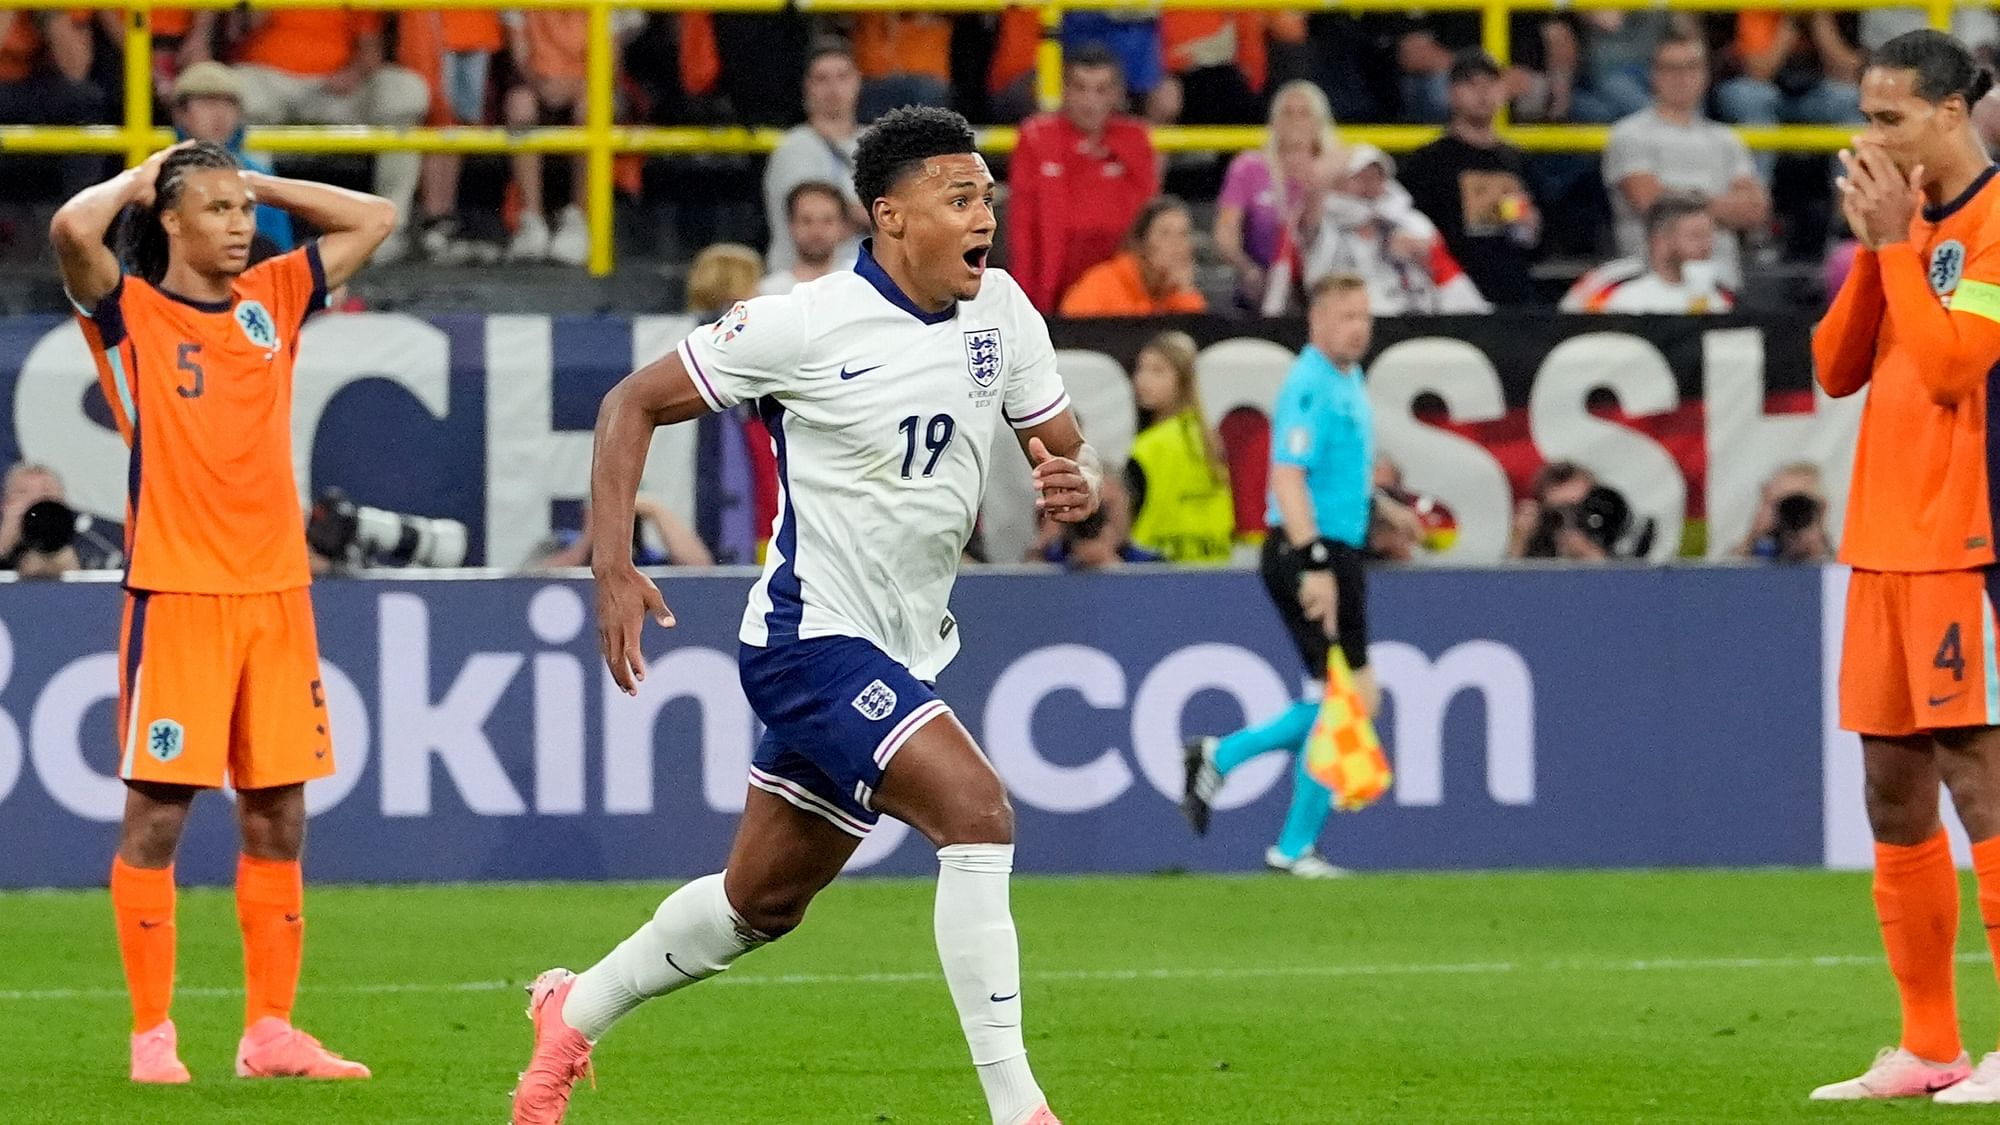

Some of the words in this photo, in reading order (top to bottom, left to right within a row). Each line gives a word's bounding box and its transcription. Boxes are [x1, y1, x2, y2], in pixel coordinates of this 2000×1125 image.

[176, 342, 205, 399] 5
[898, 413, 956, 481] 19
[1933, 621, 1965, 682] 4
